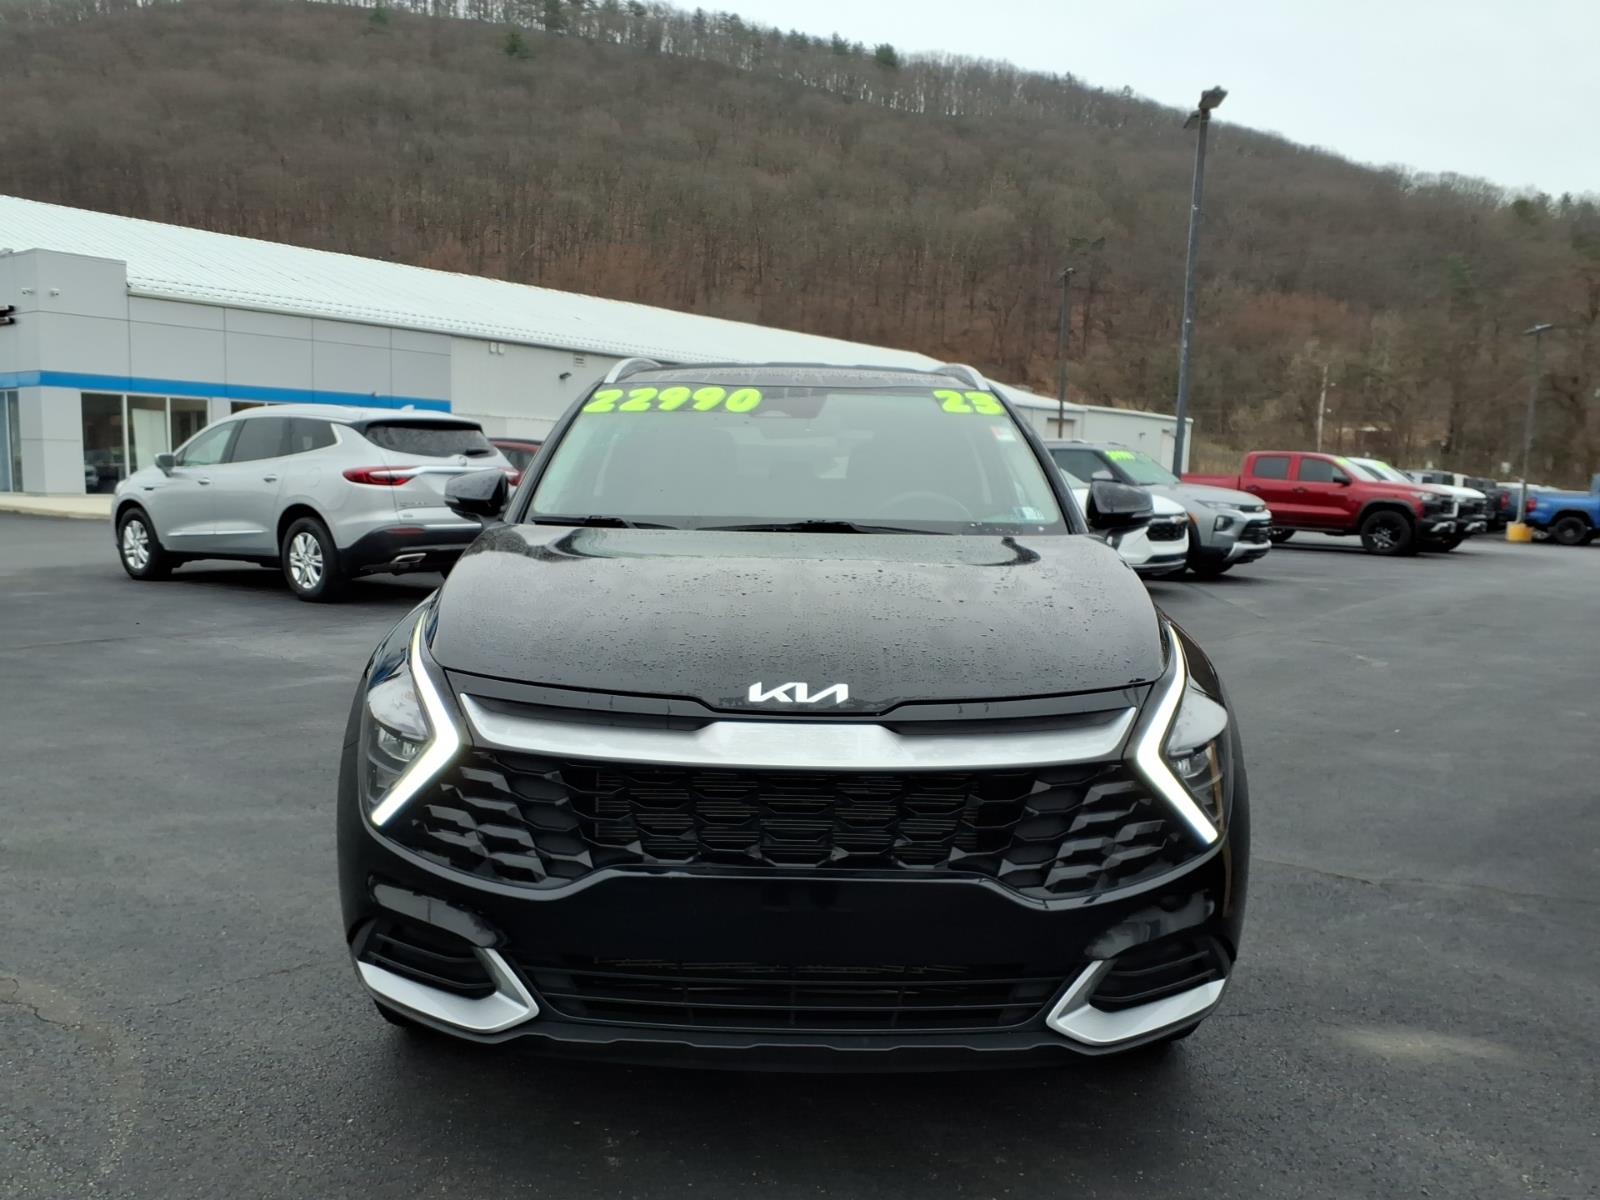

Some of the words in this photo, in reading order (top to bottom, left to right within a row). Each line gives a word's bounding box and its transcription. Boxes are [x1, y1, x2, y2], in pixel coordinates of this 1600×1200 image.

[582, 387, 763, 413] 22990
[933, 389, 1004, 415] 23
[748, 681, 849, 704] KIA
